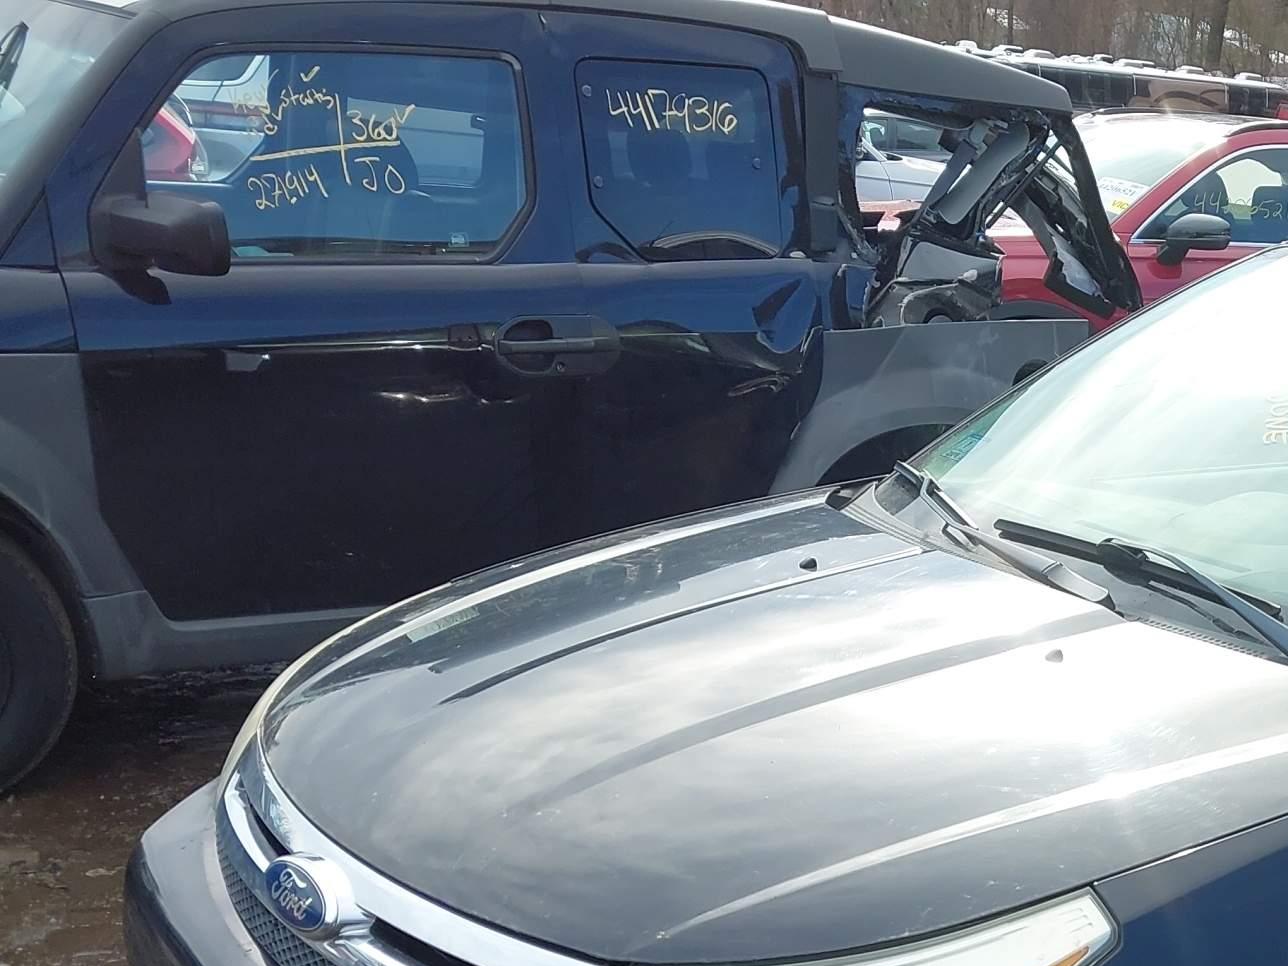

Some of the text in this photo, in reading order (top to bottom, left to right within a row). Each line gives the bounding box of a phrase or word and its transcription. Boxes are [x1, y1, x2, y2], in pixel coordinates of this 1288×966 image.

[347, 110, 398, 141] 360
[606, 89, 738, 135] 44179316
[271, 868, 313, 921] Ford
